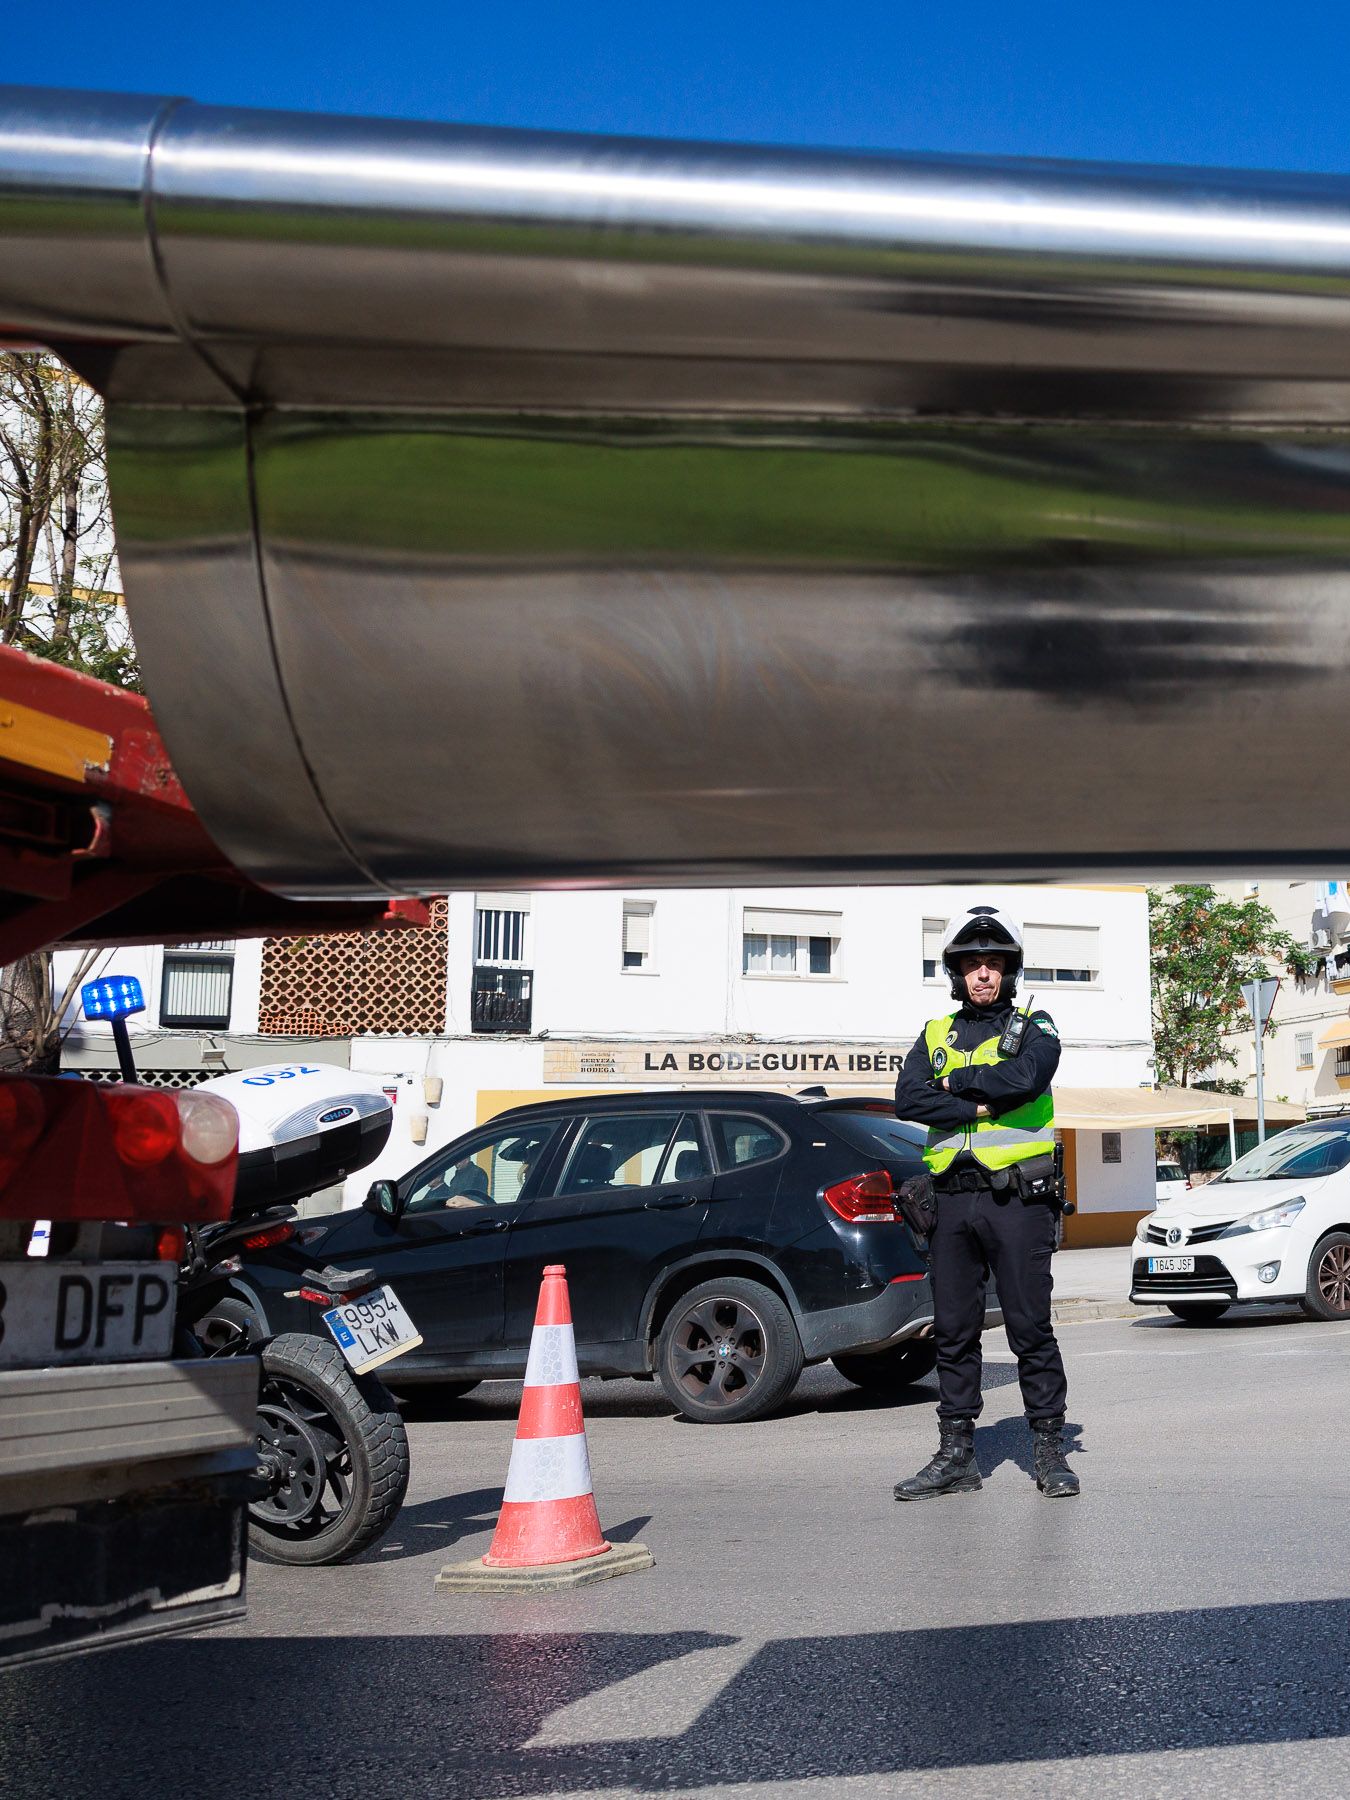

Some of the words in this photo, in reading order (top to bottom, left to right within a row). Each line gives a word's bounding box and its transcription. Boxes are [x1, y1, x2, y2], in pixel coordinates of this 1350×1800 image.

[644, 1053, 679, 1071] LA
[688, 1053, 840, 1071] BODEGUITA
[242, 1066, 320, 1086] 092
[323, 1107, 352, 1122] SHAD
[1156, 1259, 1174, 1271] 1645
[1177, 1258, 1192, 1270] JSF
[54, 1273, 170, 1350] DFP
[343, 1291, 398, 1330] 9954
[356, 1318, 399, 1355] LKW
